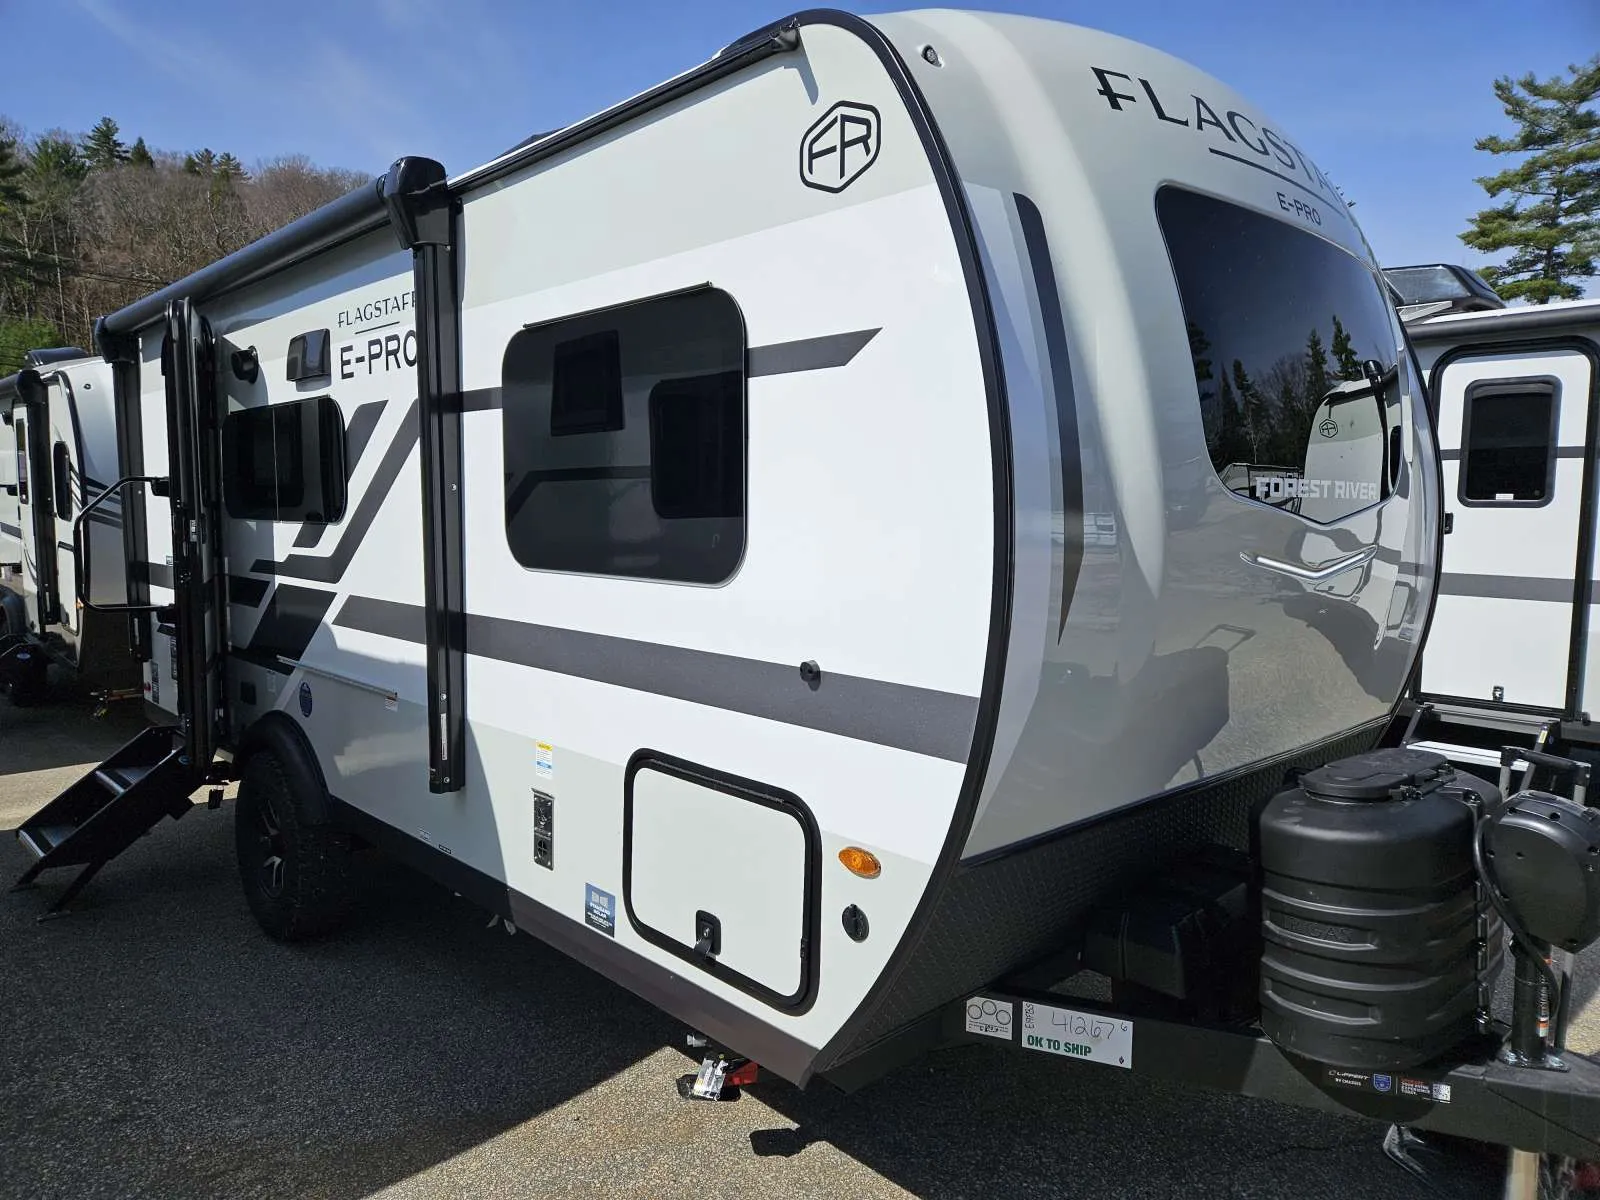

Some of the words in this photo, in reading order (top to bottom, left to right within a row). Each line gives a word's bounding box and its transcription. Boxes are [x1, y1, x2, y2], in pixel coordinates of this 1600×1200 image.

[1090, 66, 1352, 206] FLAGSTA
[1276, 191, 1321, 226] E-PRO
[340, 330, 417, 380] E-PRO
[1255, 477, 1333, 499] FOREST
[1334, 481, 1377, 500] RIVER
[1027, 1035, 1044, 1048] OK
[1046, 1039, 1061, 1051] TO
[1063, 1043, 1092, 1057] SHIP
